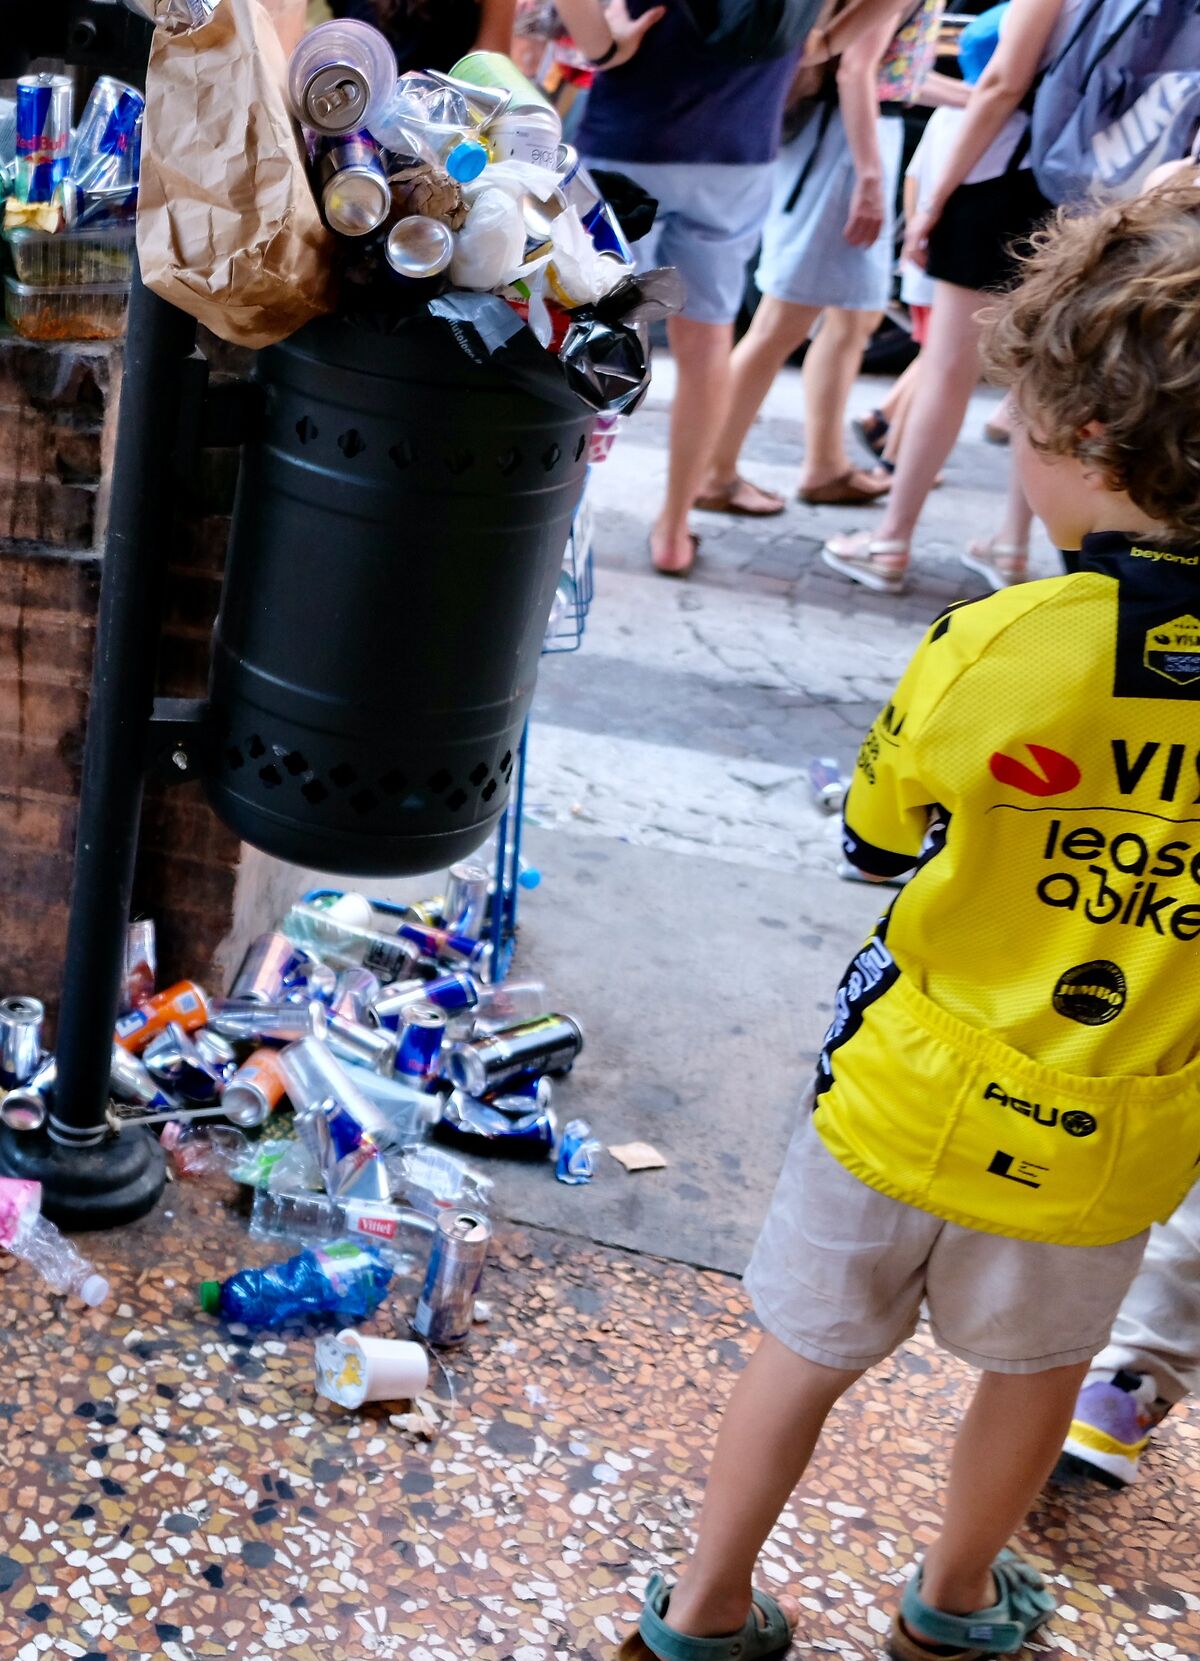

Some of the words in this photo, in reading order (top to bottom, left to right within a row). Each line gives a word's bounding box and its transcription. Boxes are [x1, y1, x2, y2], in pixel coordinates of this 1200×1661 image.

[37, 132, 68, 151] Bull
[1130, 546, 1199, 566] beyond
[1111, 739, 1200, 805] VI
[1044, 819, 1200, 887] leas
[983, 1082, 1059, 1127] AGU
[361, 1218, 392, 1235] Vittel
